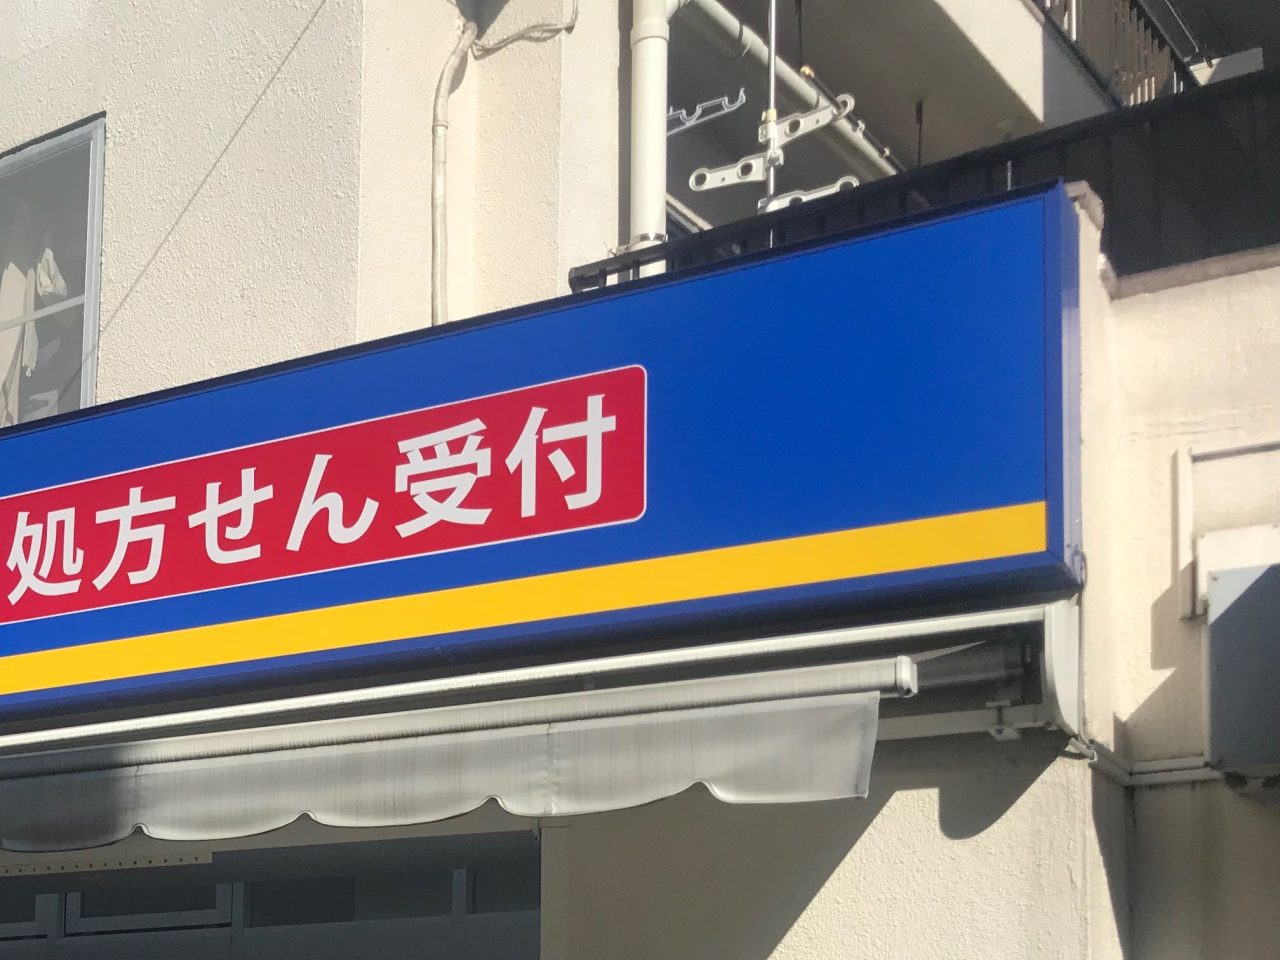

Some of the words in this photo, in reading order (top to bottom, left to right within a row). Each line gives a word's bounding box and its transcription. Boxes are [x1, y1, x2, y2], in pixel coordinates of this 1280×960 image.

[6, 394, 617, 605] 処方せん受付
